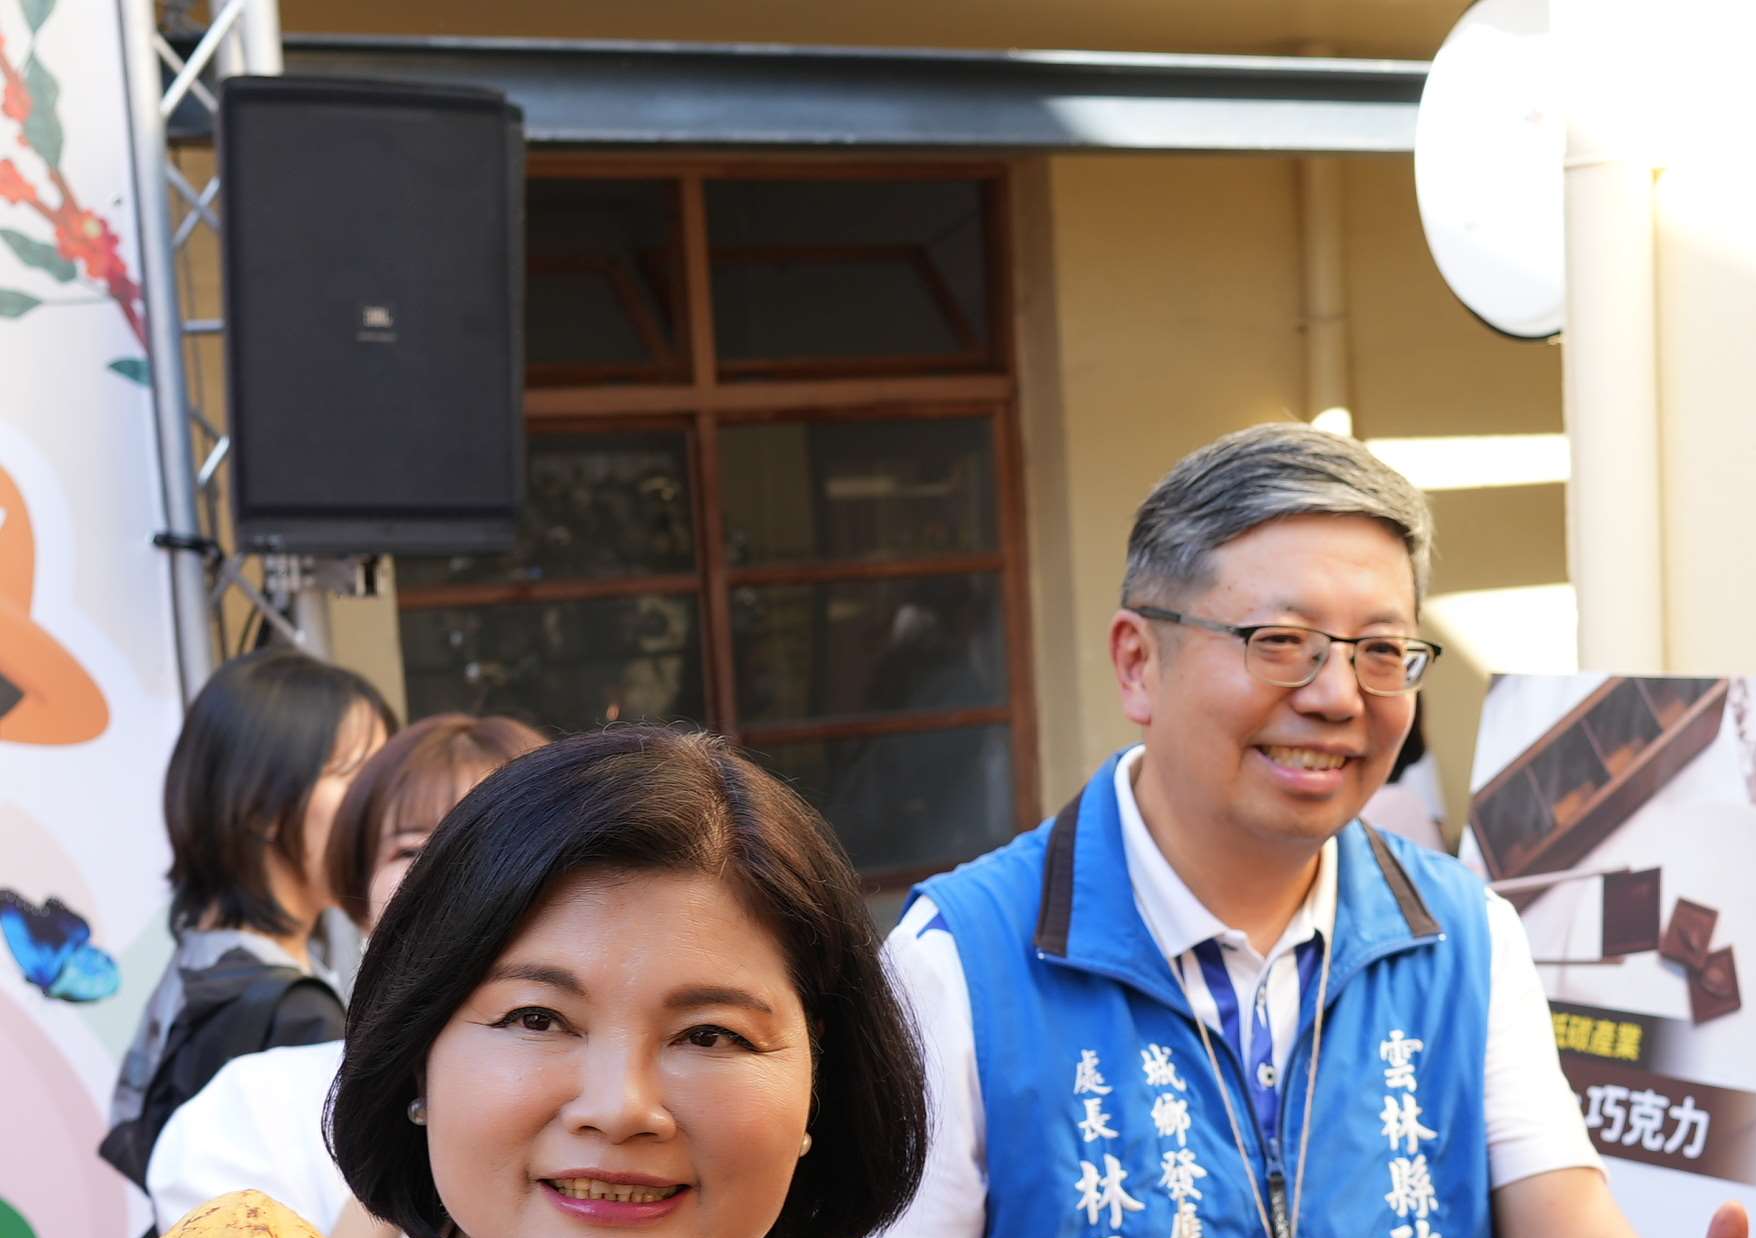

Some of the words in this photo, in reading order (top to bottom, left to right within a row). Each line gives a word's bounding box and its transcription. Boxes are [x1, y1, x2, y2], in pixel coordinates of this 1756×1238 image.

[1073, 1049, 1119, 1142] 處長
[1576, 1084, 1709, 1159] 巧克力
